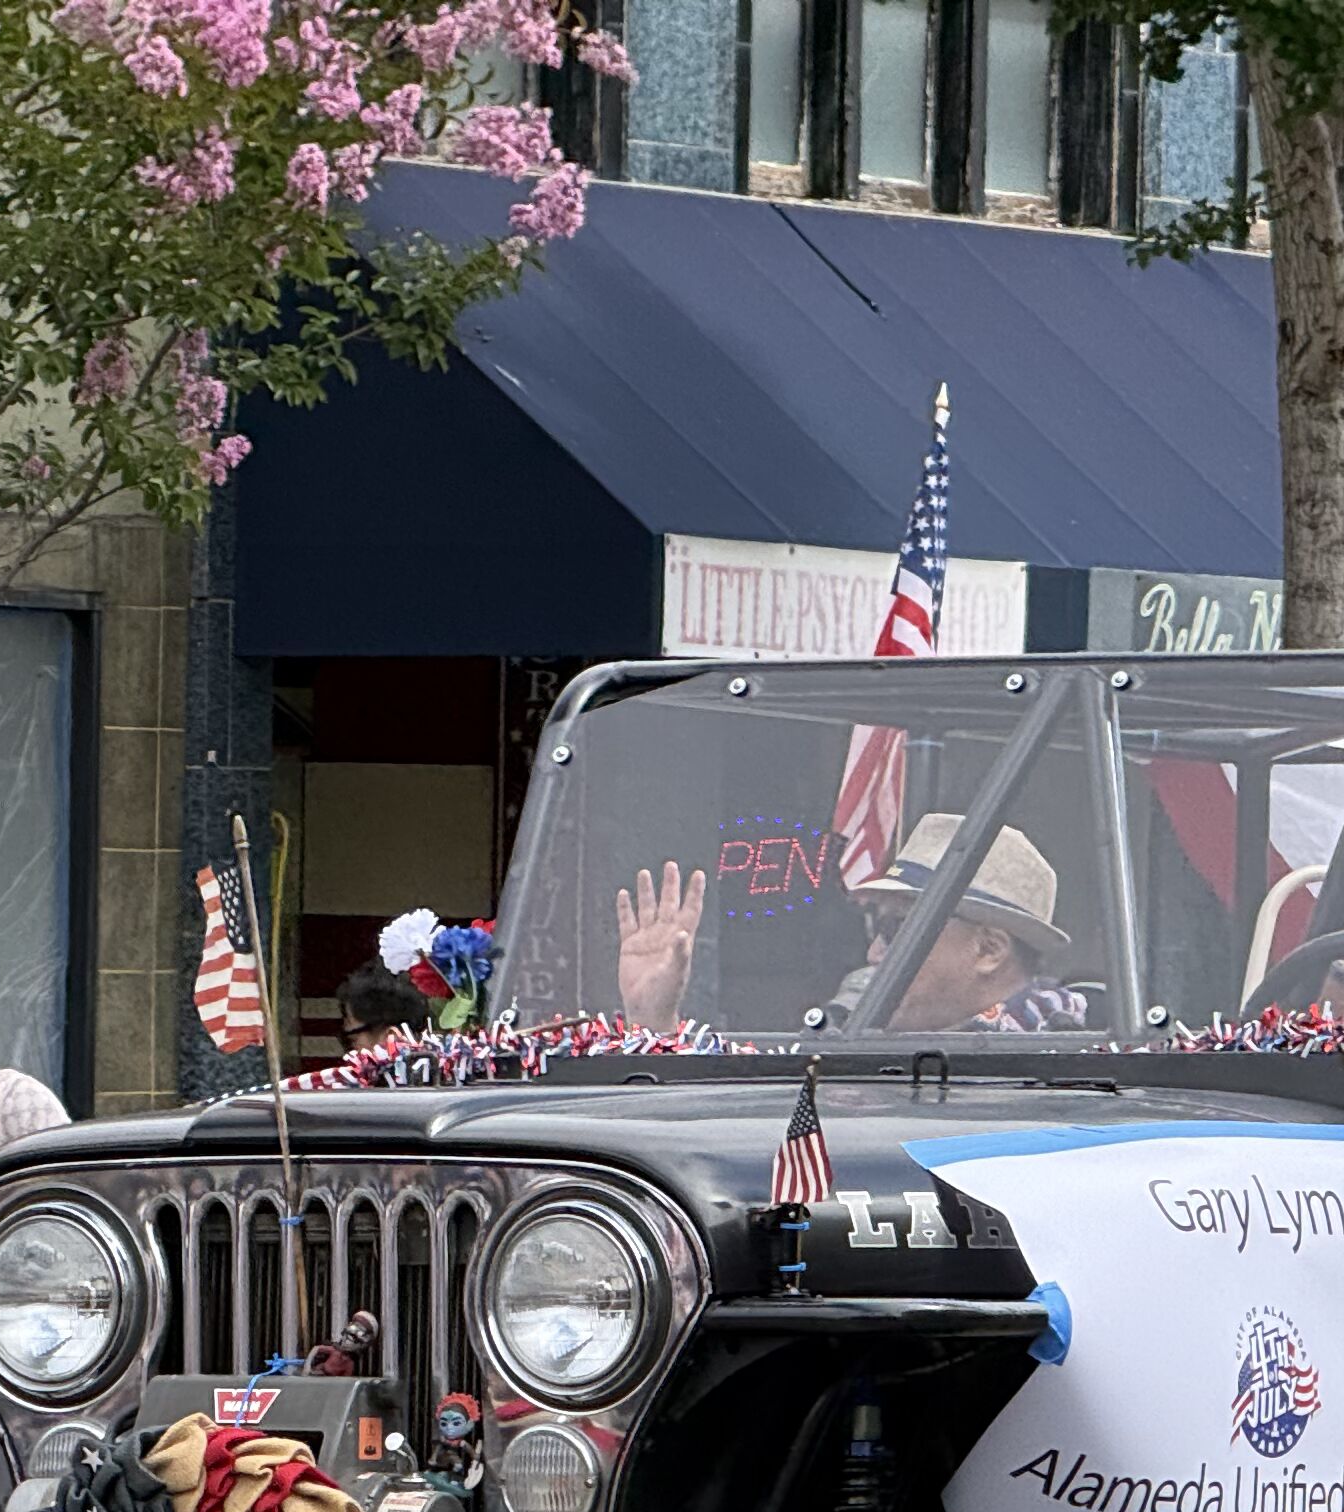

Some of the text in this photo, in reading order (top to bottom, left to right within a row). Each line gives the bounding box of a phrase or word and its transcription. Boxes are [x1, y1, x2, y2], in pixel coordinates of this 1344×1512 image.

[717, 838, 826, 894] PEN
[1148, 1179, 1249, 1254] Gary
[1247, 1376, 1298, 1428] JULY
